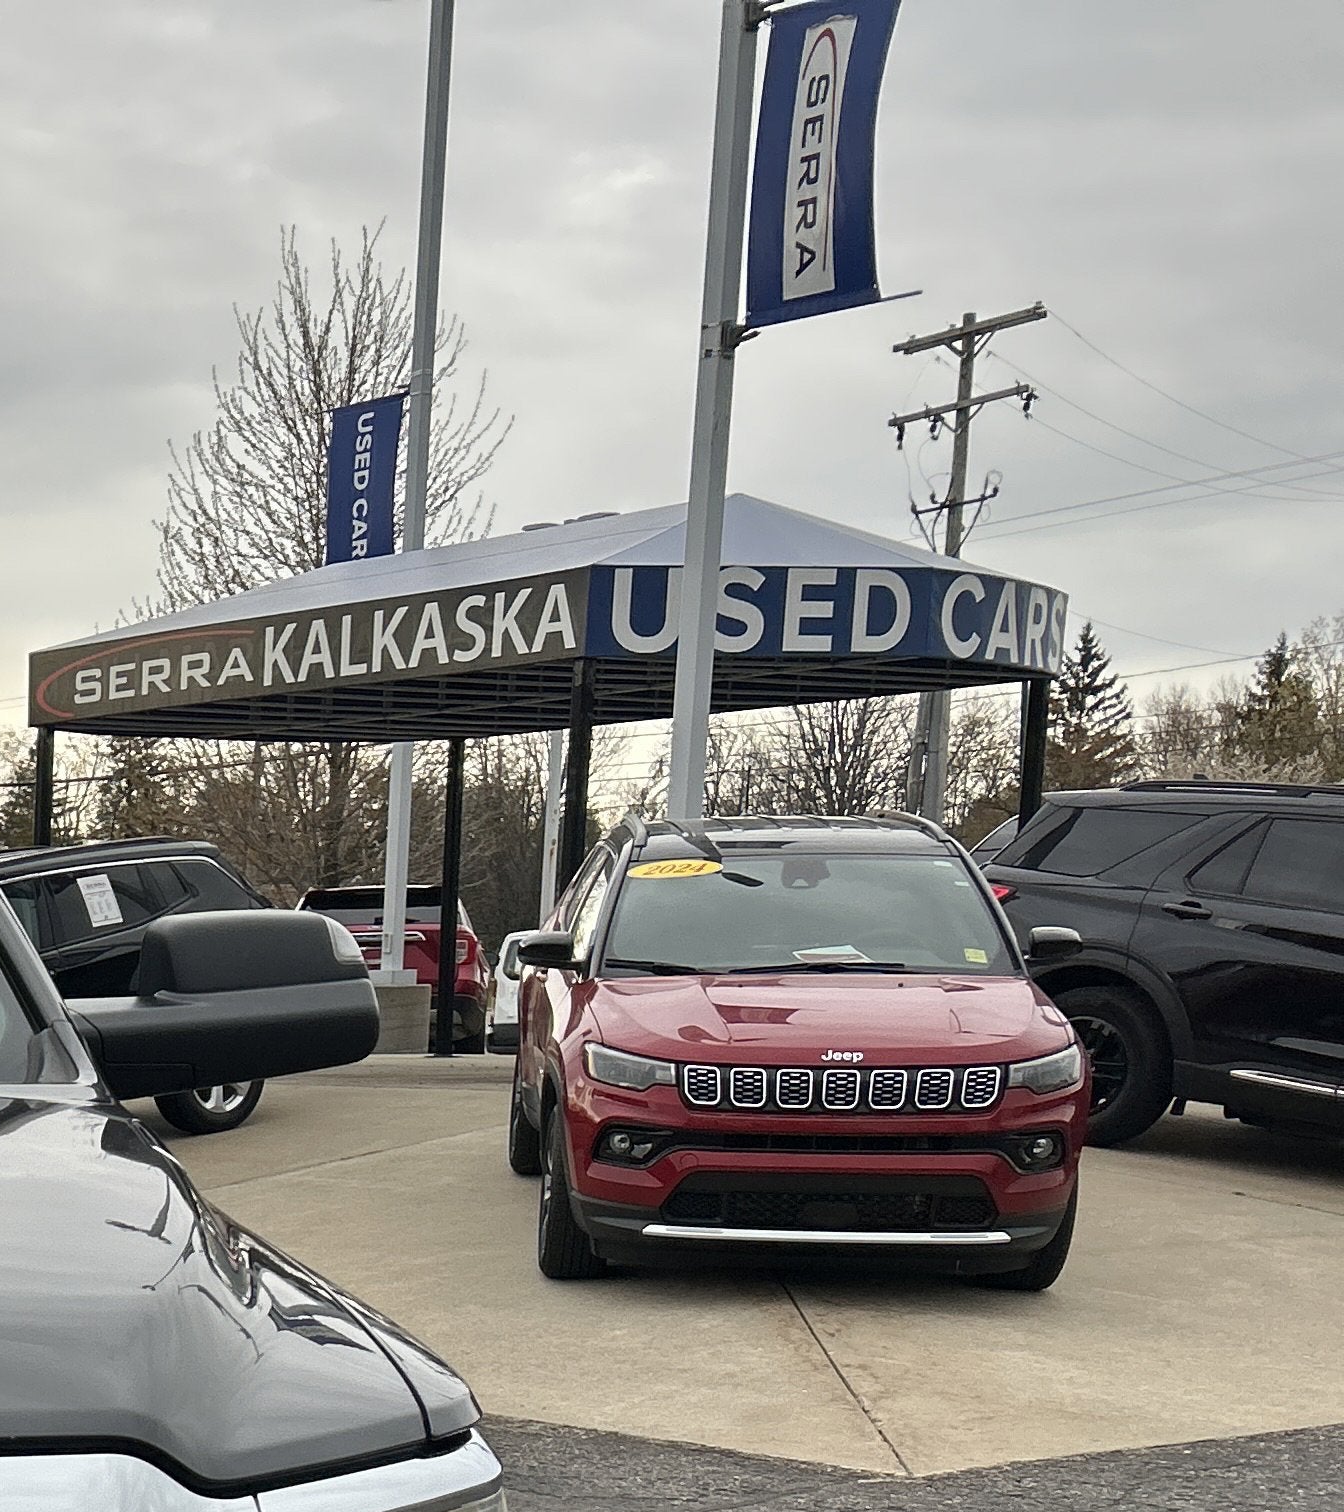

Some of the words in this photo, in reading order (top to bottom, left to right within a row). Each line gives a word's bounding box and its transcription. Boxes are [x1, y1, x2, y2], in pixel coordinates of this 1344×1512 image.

[794, 74, 830, 280] SERRA
[353, 411, 376, 491] USED
[74, 647, 254, 704] SERRA
[263, 583, 576, 686] KALKASKA
[612, 567, 912, 653] USED
[941, 573, 1067, 673] CARS
[642, 863, 708, 876] 2024
[821, 1049, 864, 1063] Jeep
